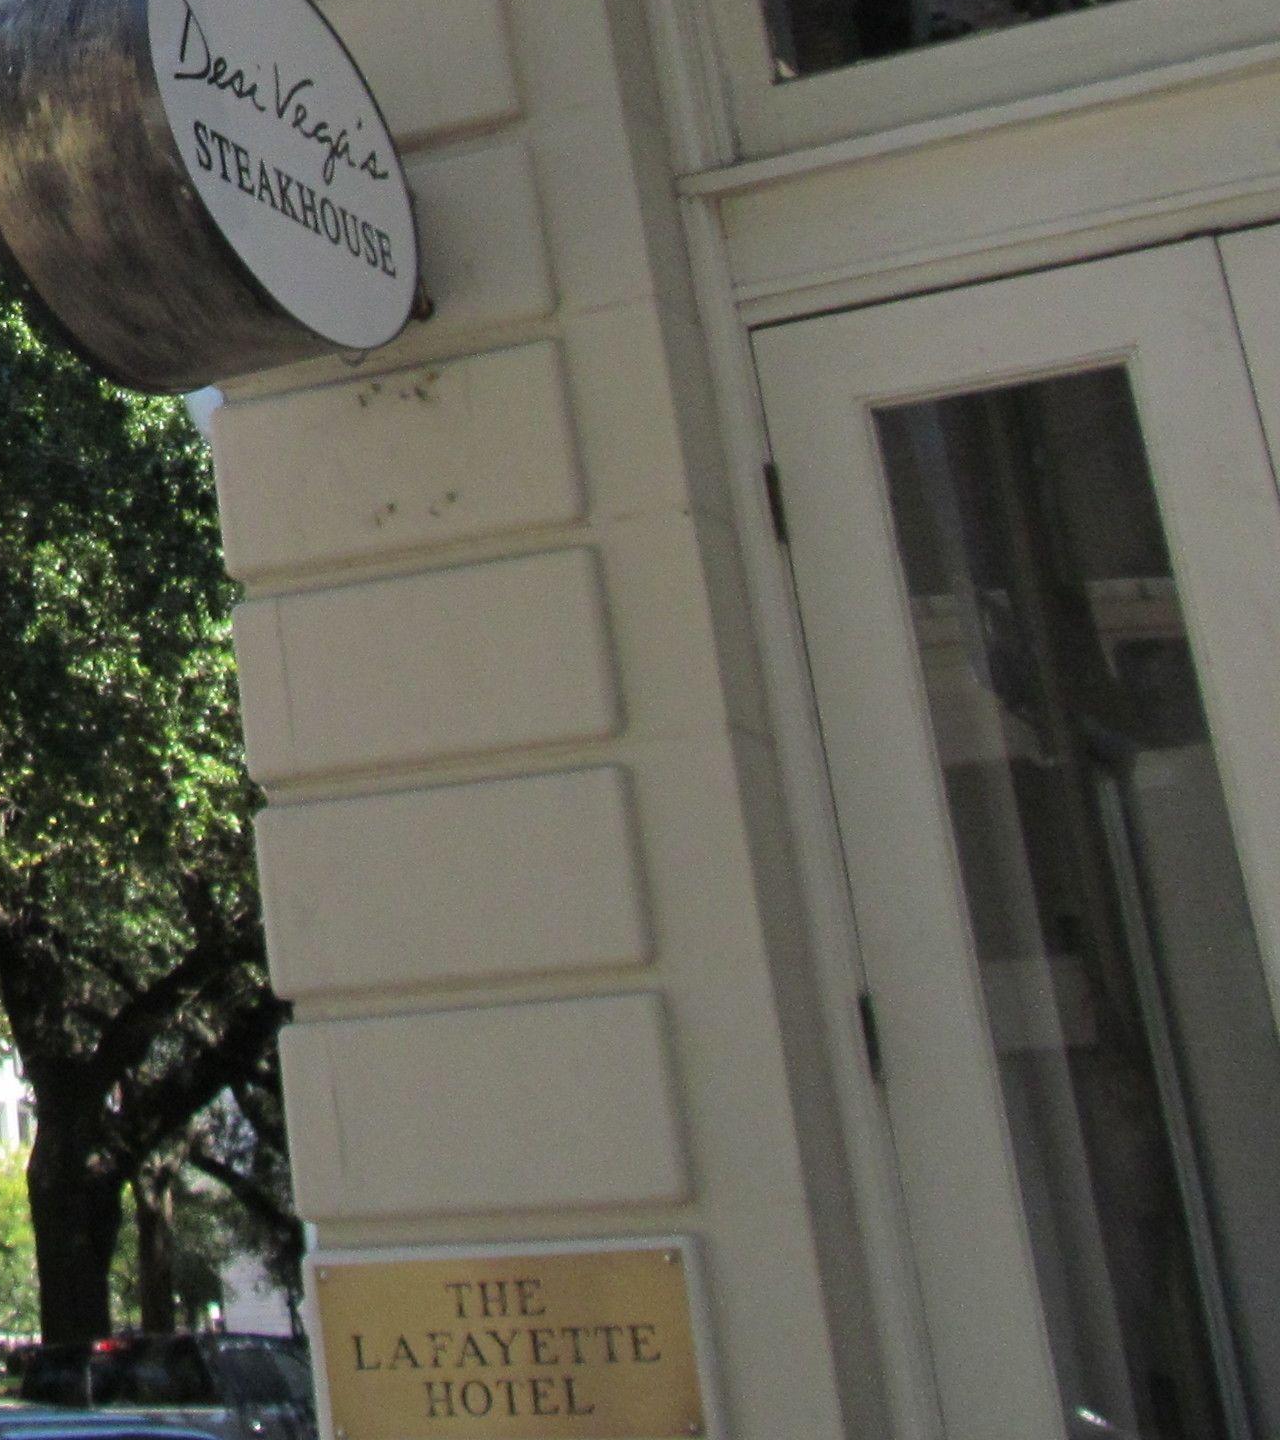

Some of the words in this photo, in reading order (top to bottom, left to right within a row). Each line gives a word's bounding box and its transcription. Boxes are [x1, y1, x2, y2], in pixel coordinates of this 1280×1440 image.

[194, 120, 397, 279] STEAKHOUSE
[444, 1278, 547, 1319] THE
[352, 1324, 661, 1371] LAFAYETTE
[425, 1376, 595, 1418] HOTEL
